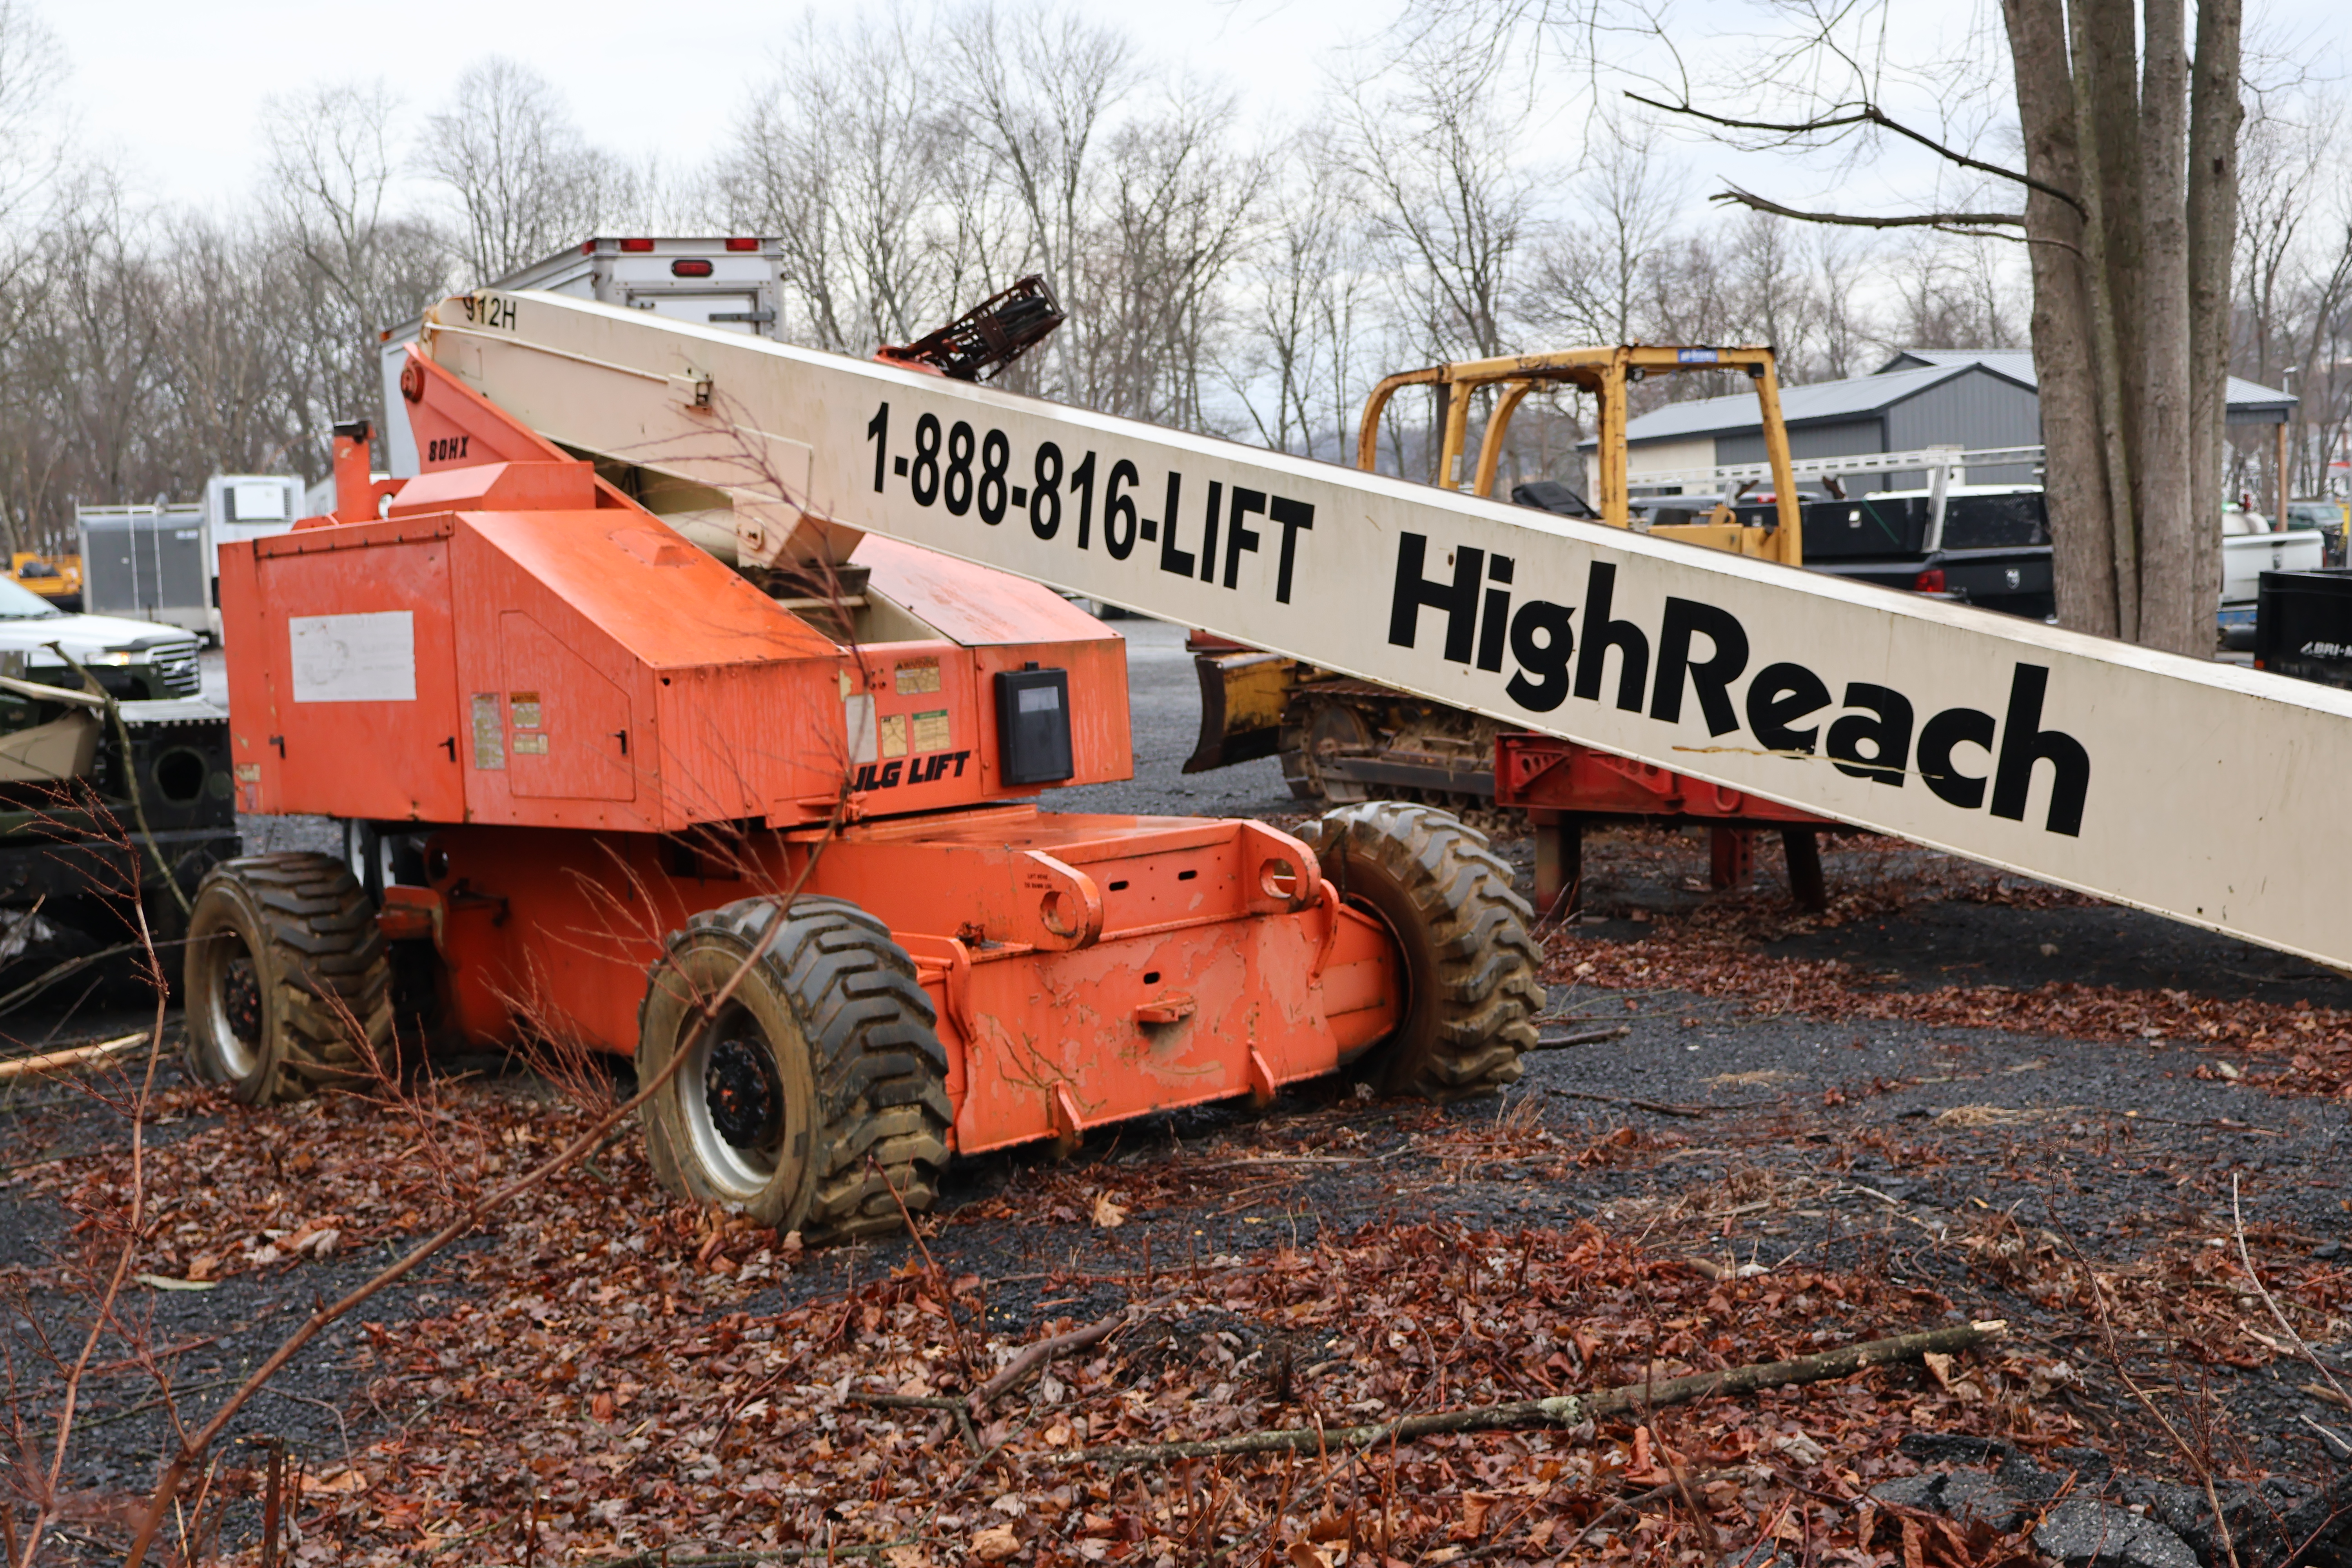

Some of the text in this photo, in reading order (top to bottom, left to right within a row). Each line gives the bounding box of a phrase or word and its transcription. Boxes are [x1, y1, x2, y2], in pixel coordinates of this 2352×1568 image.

[463, 296, 516, 330] 912H
[429, 436, 468, 462] 80HX
[867, 401, 1316, 605] 1-888-816-LIFT
[1388, 531, 2090, 838] HighReach
[853, 751, 971, 791] JLG LIFT
